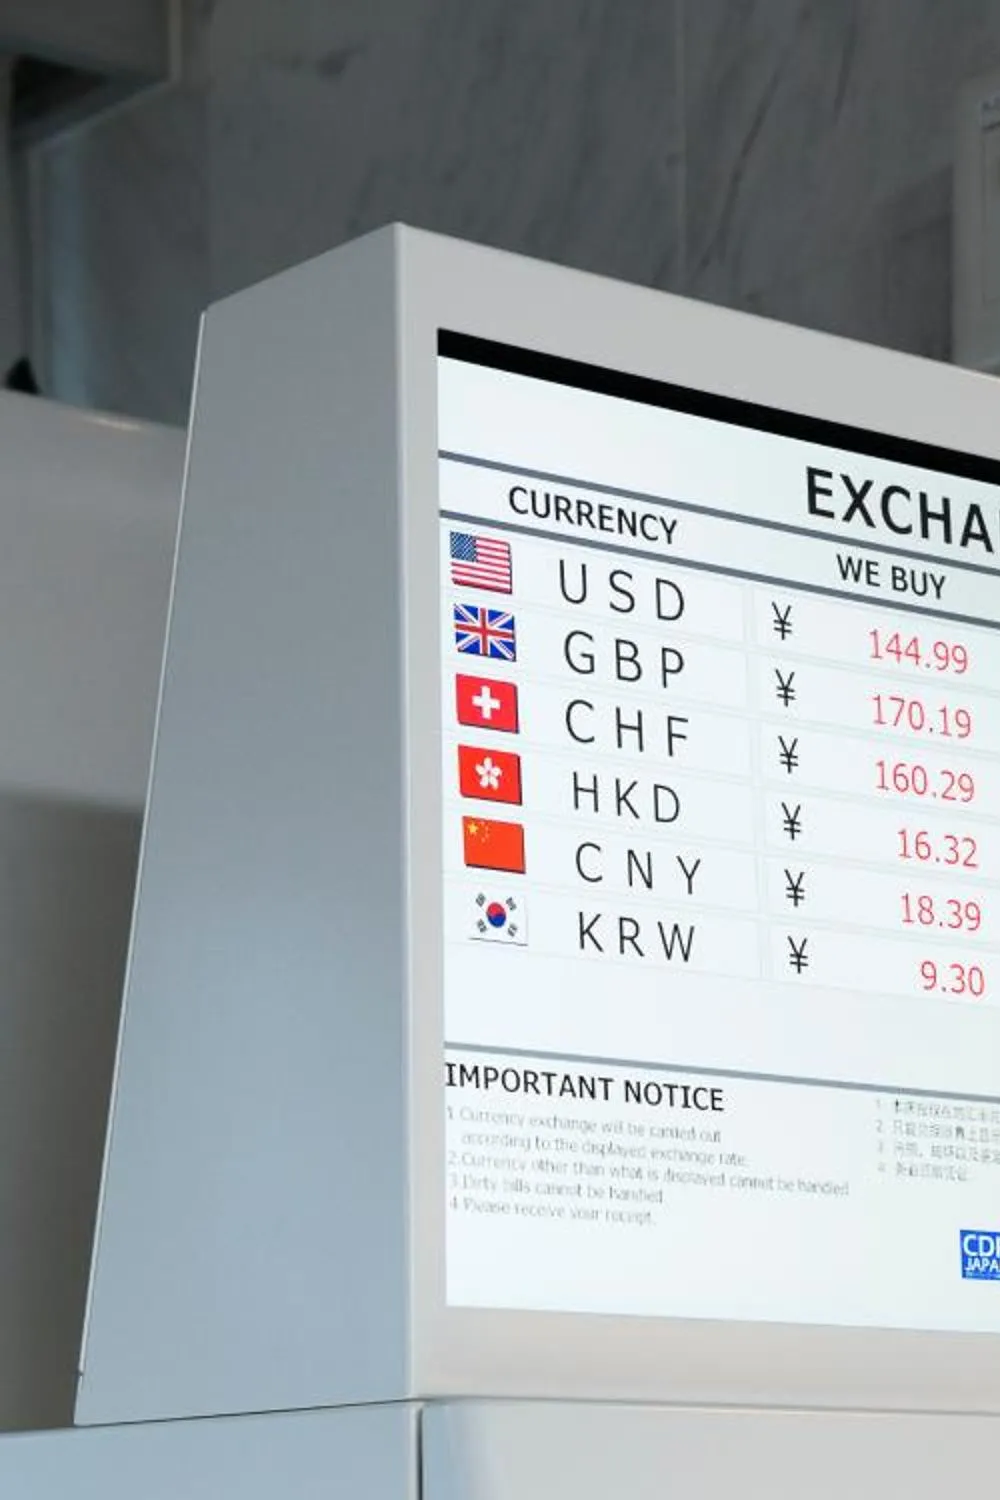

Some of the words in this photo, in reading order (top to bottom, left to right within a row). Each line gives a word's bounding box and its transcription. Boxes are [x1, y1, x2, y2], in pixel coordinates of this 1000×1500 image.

[508, 485, 677, 545] CURRENCY
[559, 559, 685, 621] USD
[870, 629, 968, 674] 144.99
[837, 553, 881, 587] WE
[891, 560, 946, 599] BUY
[564, 629, 684, 688] GBP
[872, 695, 971, 739] 170.19
[565, 699, 687, 757] CHF
[876, 761, 975, 803] 160.29
[572, 771, 680, 824] HKD
[898, 830, 977, 868] 16.32
[576, 842, 700, 895] CNY
[901, 893, 981, 931] 18.39
[579, 912, 695, 963] KRW
[920, 961, 985, 997] 9.30
[446, 1063, 614, 1102] IMPORTANT
[624, 1079, 725, 1112] NOTICE
